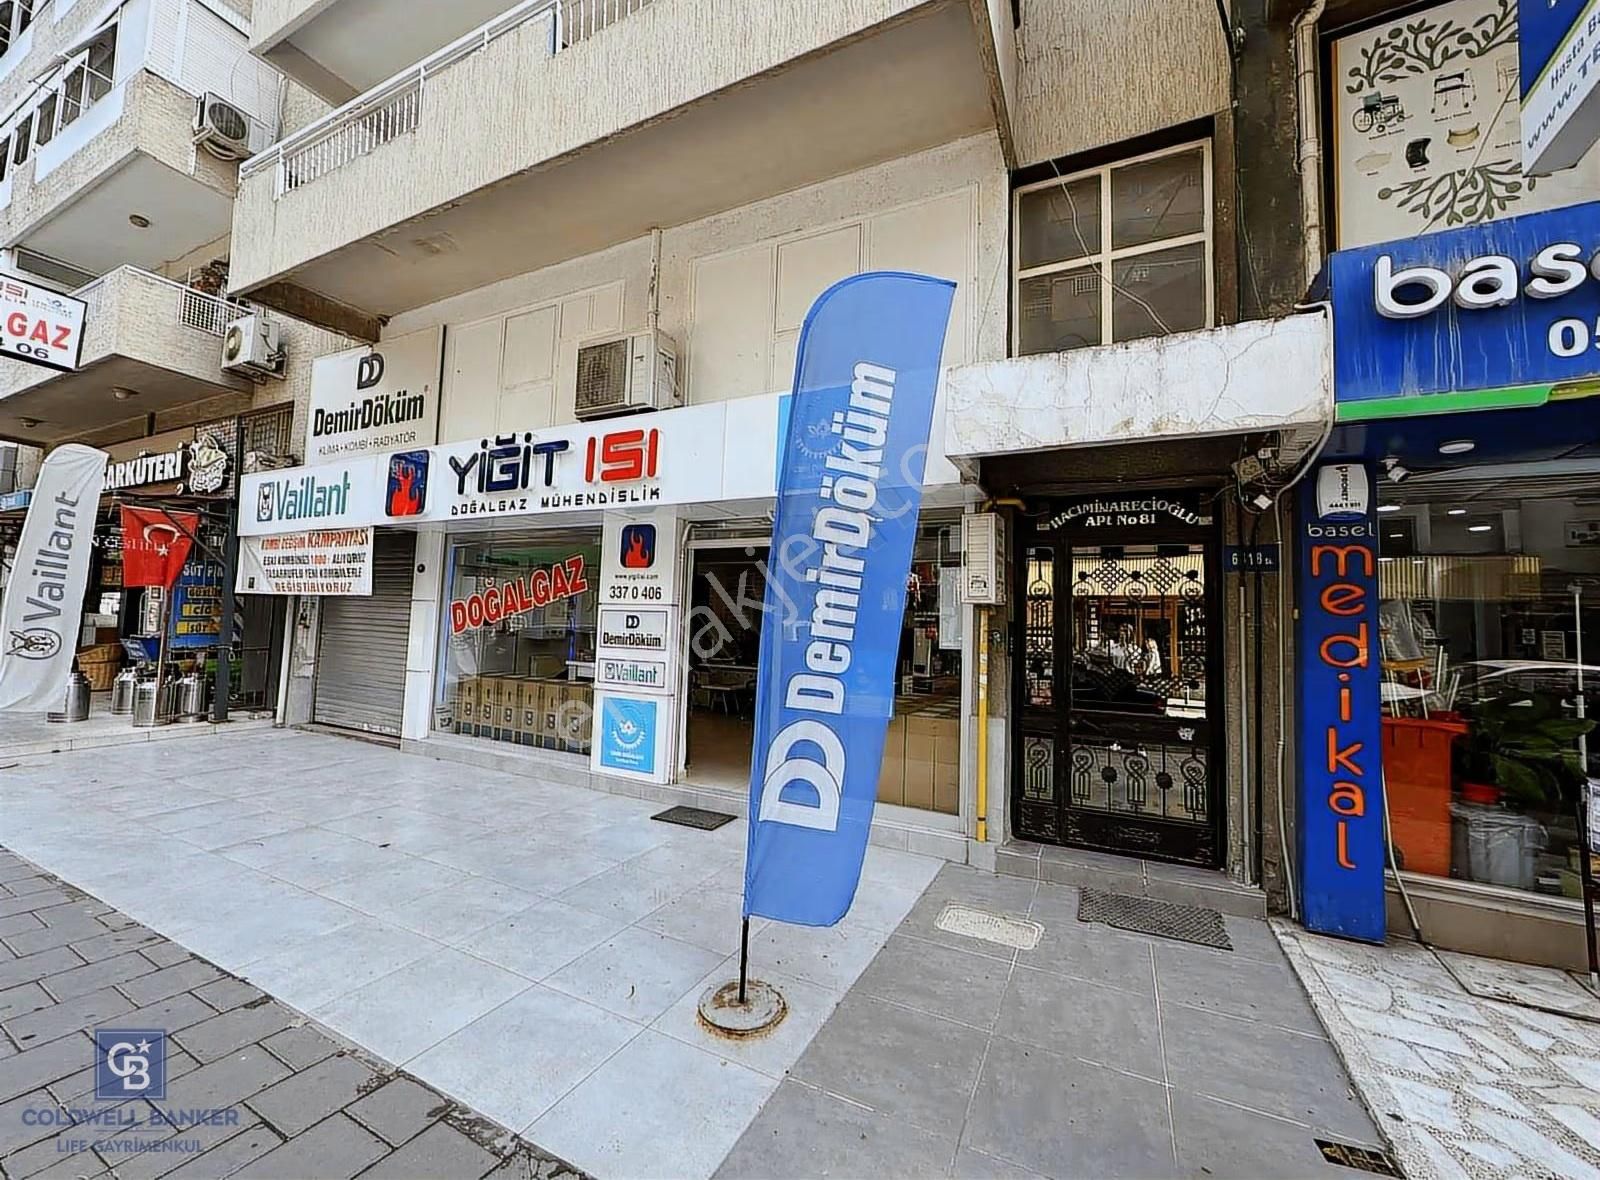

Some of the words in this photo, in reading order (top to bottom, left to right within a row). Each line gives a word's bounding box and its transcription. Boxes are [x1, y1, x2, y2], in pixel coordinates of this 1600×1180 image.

[1549, 36, 1584, 91] Hasta
[1374, 243, 1600, 319] bas
[313, 390, 425, 437] DemirDöküm
[449, 432, 570, 495] YİĞİT
[585, 428, 660, 483] ISI
[276, 470, 351, 520] Vaillant
[451, 498, 527, 516] DOĞALGAZ
[541, 484, 660, 508] MÜHENDİSLİK
[786, 359, 897, 714] DemirDöküm
[1308, 522, 1376, 537] basel
[22, 491, 80, 623] Vaillant
[1232, 552, 1263, 566] 618
[450, 554, 588, 635] DOĞALGAZ
[609, 586, 629, 599] 337
[631, 586, 639, 599] 0
[641, 586, 662, 600] 406
[603, 632, 662, 647] DemirDöküm
[616, 663, 658, 684] Vaillant
[1311, 544, 1373, 869] medikal
